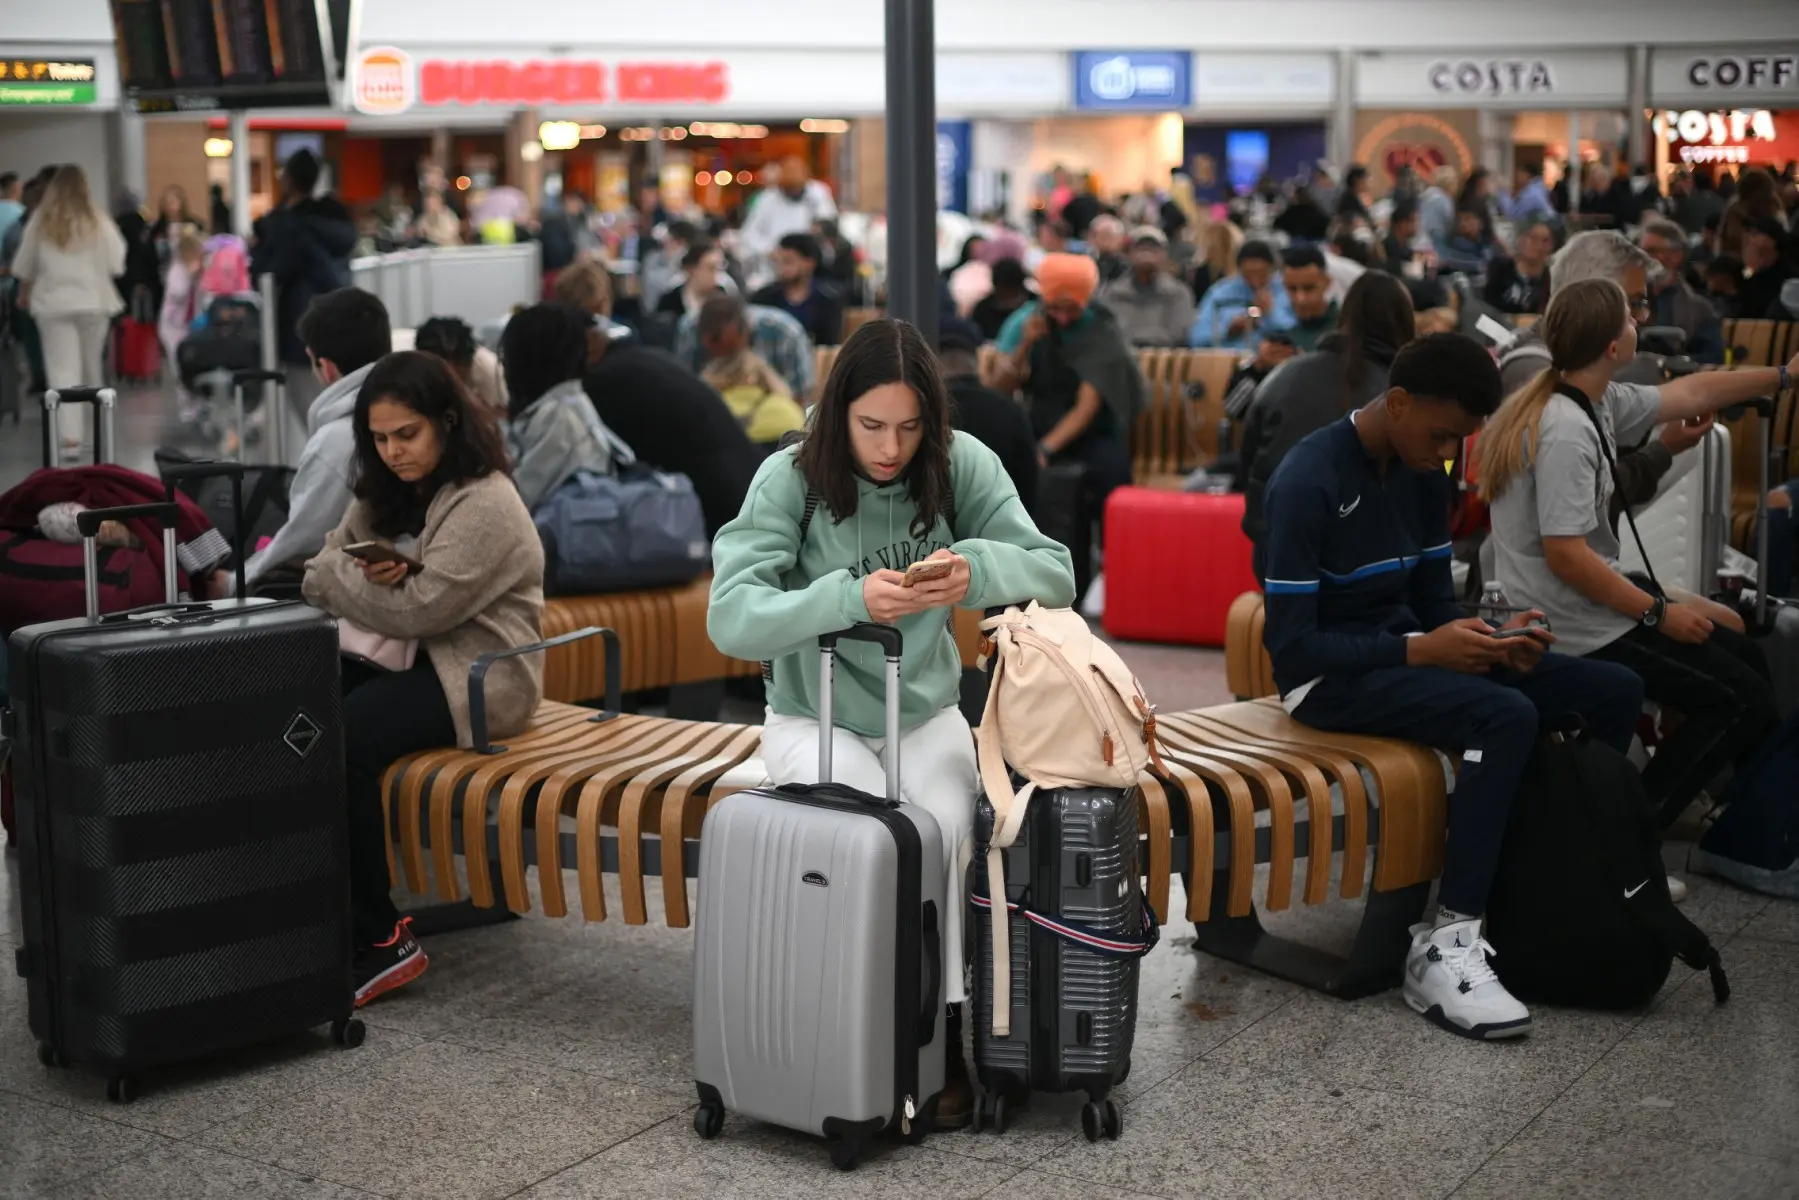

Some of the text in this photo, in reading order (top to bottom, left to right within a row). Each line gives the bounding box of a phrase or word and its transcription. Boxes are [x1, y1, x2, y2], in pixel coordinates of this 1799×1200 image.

[1431, 62, 1552, 96] COSTA
[1689, 58, 1799, 86] COFF
[1653, 110, 1776, 145] COSTA
[848, 556, 871, 579] ST
[397, 940, 415, 957] AIR
